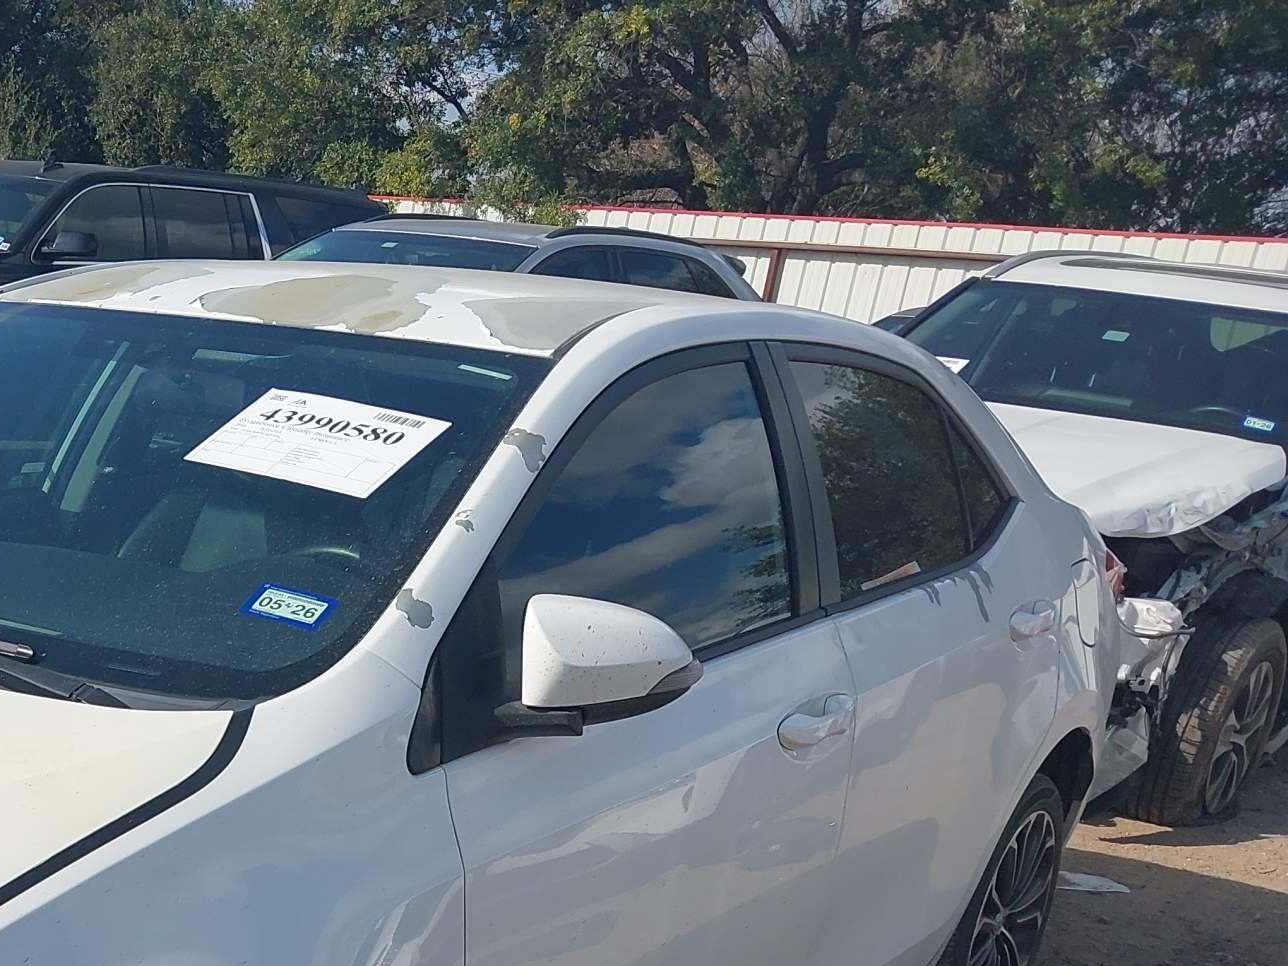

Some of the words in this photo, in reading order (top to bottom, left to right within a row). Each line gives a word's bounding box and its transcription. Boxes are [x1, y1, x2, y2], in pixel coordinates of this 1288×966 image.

[259, 408, 406, 446] 43990580
[258, 596, 286, 611] 05
[290, 604, 319, 619] 26
